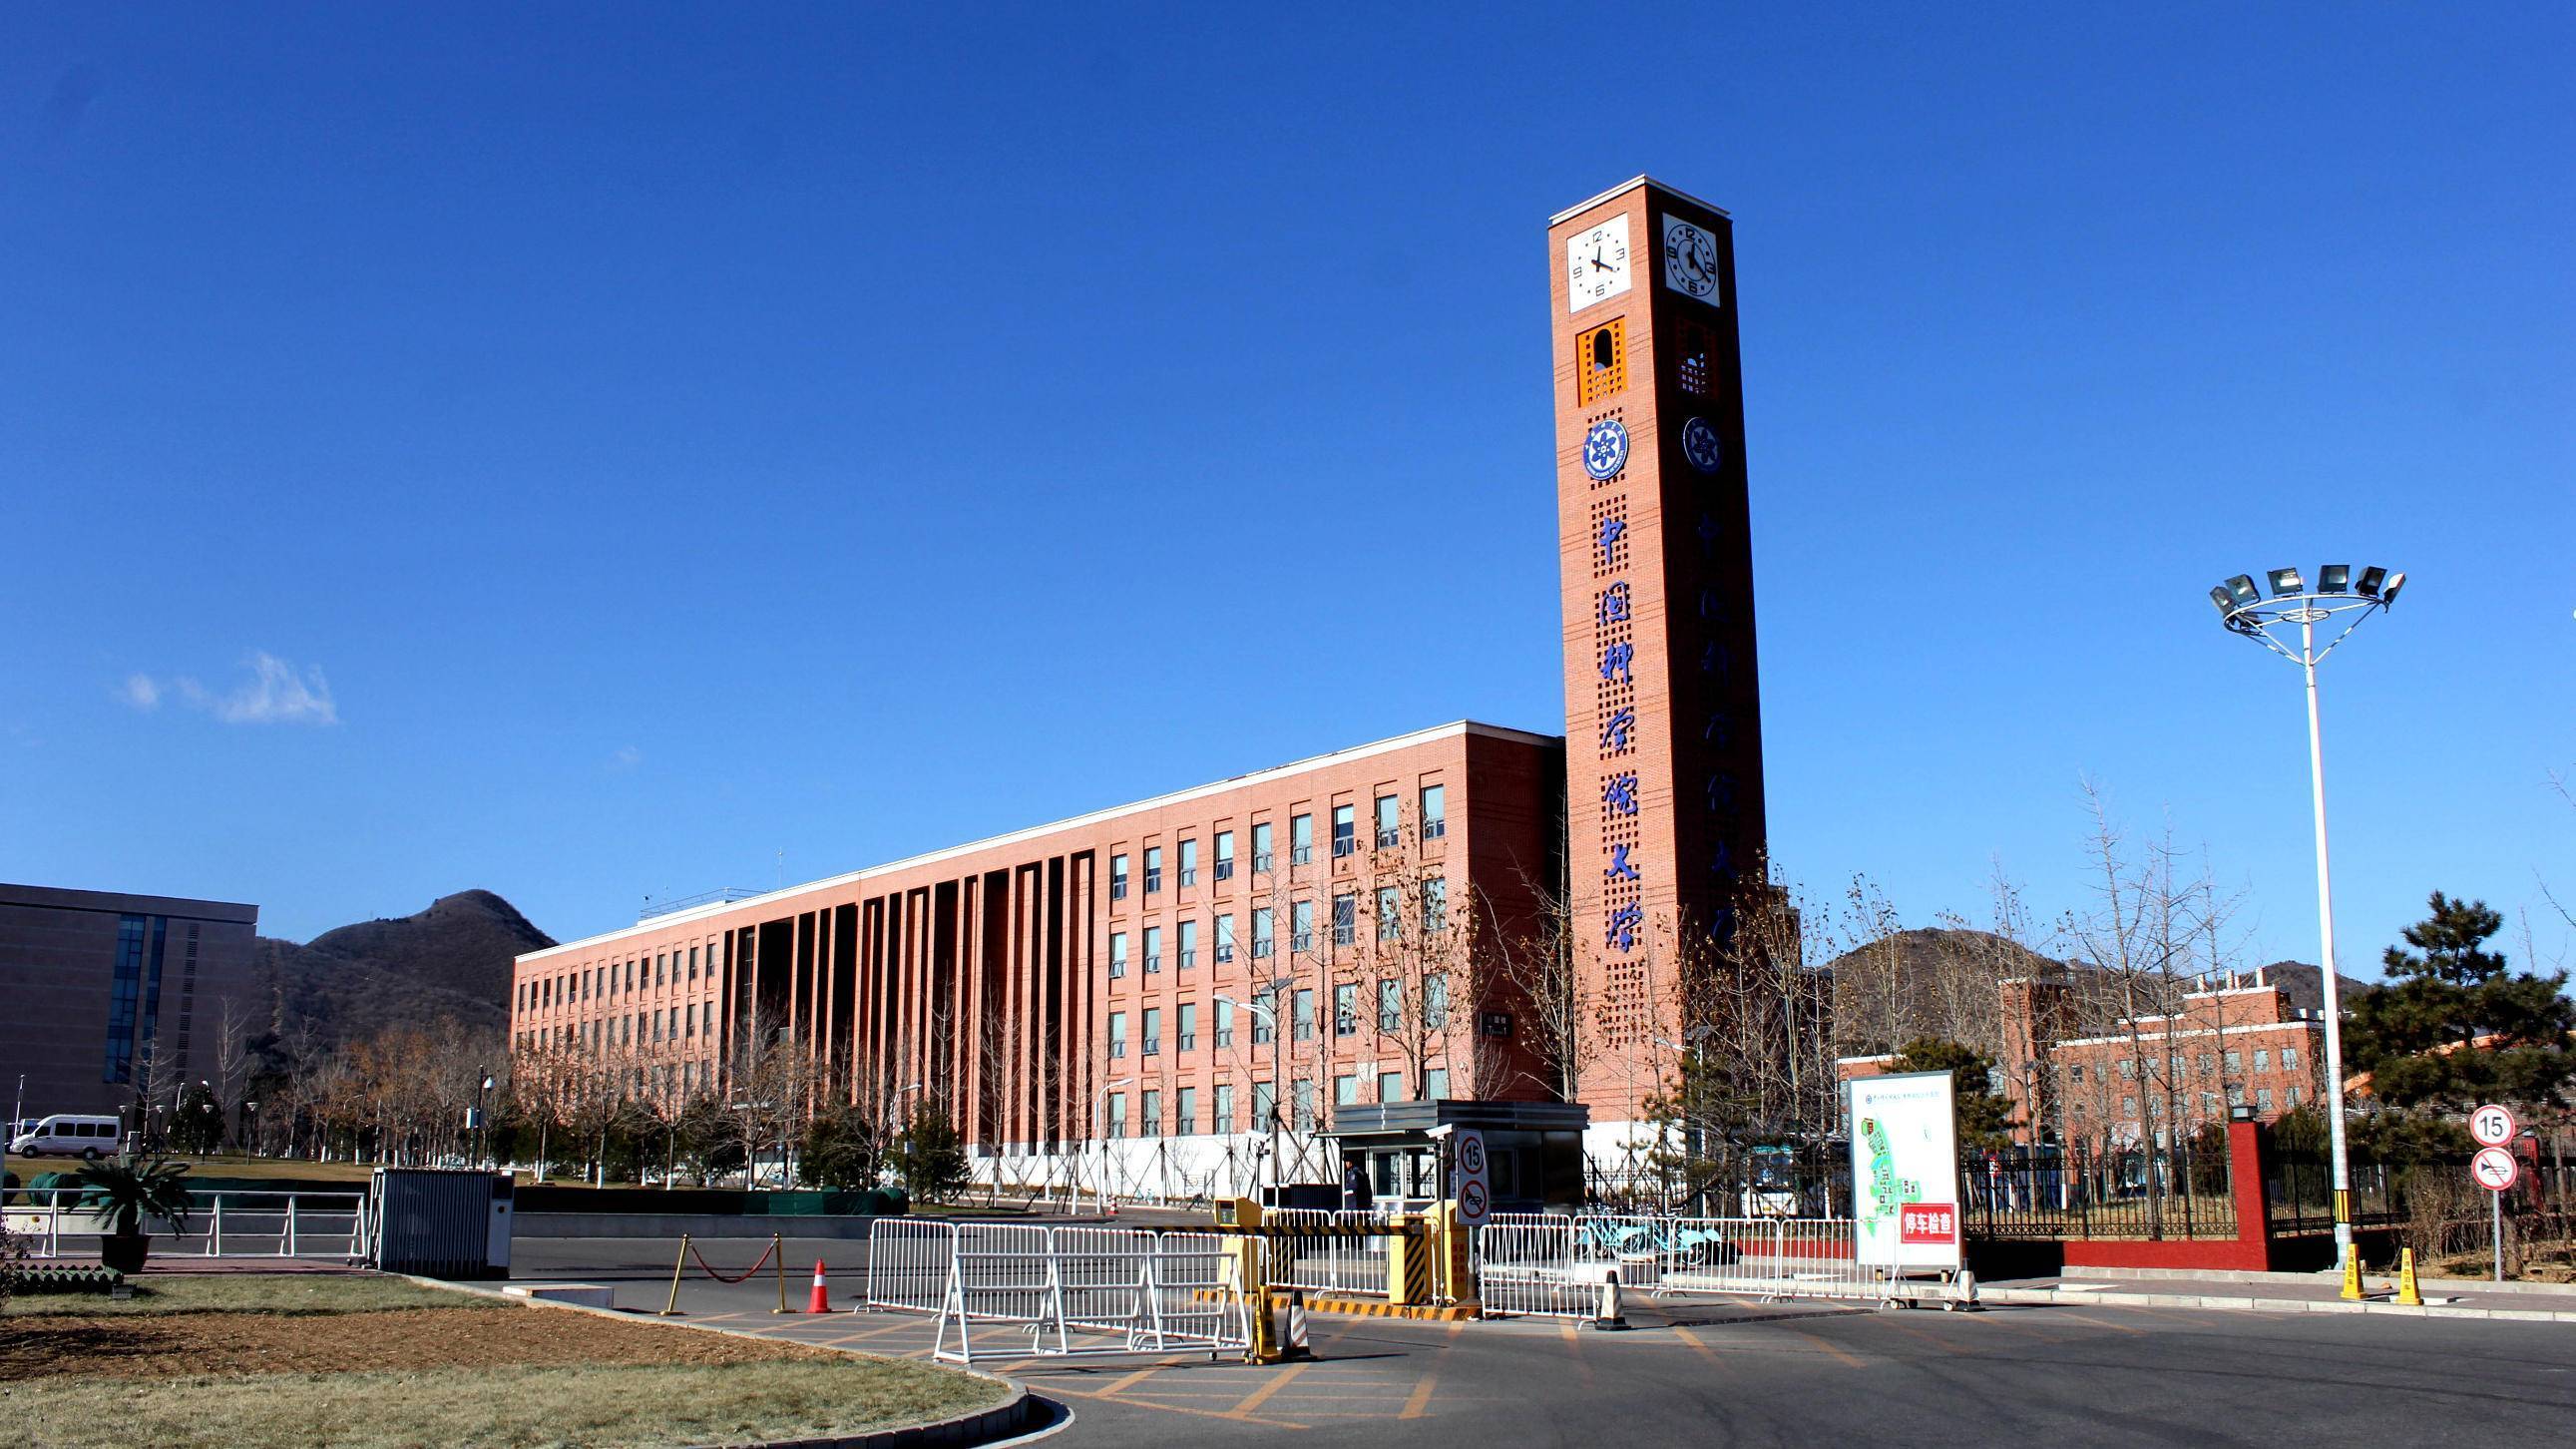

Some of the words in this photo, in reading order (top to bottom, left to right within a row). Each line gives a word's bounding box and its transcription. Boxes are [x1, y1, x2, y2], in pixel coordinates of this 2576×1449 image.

[1593, 231, 1602, 243] 12
[1615, 247, 1624, 260] 3
[1572, 266, 1582, 278] 9
[1596, 284, 1604, 296] 6
[1598, 517, 1642, 954] 中国科学院大学
[2479, 1116, 2503, 1138] 15
[1467, 1146, 1481, 1167] 15
[1905, 1212, 1952, 1234] 停车检查
